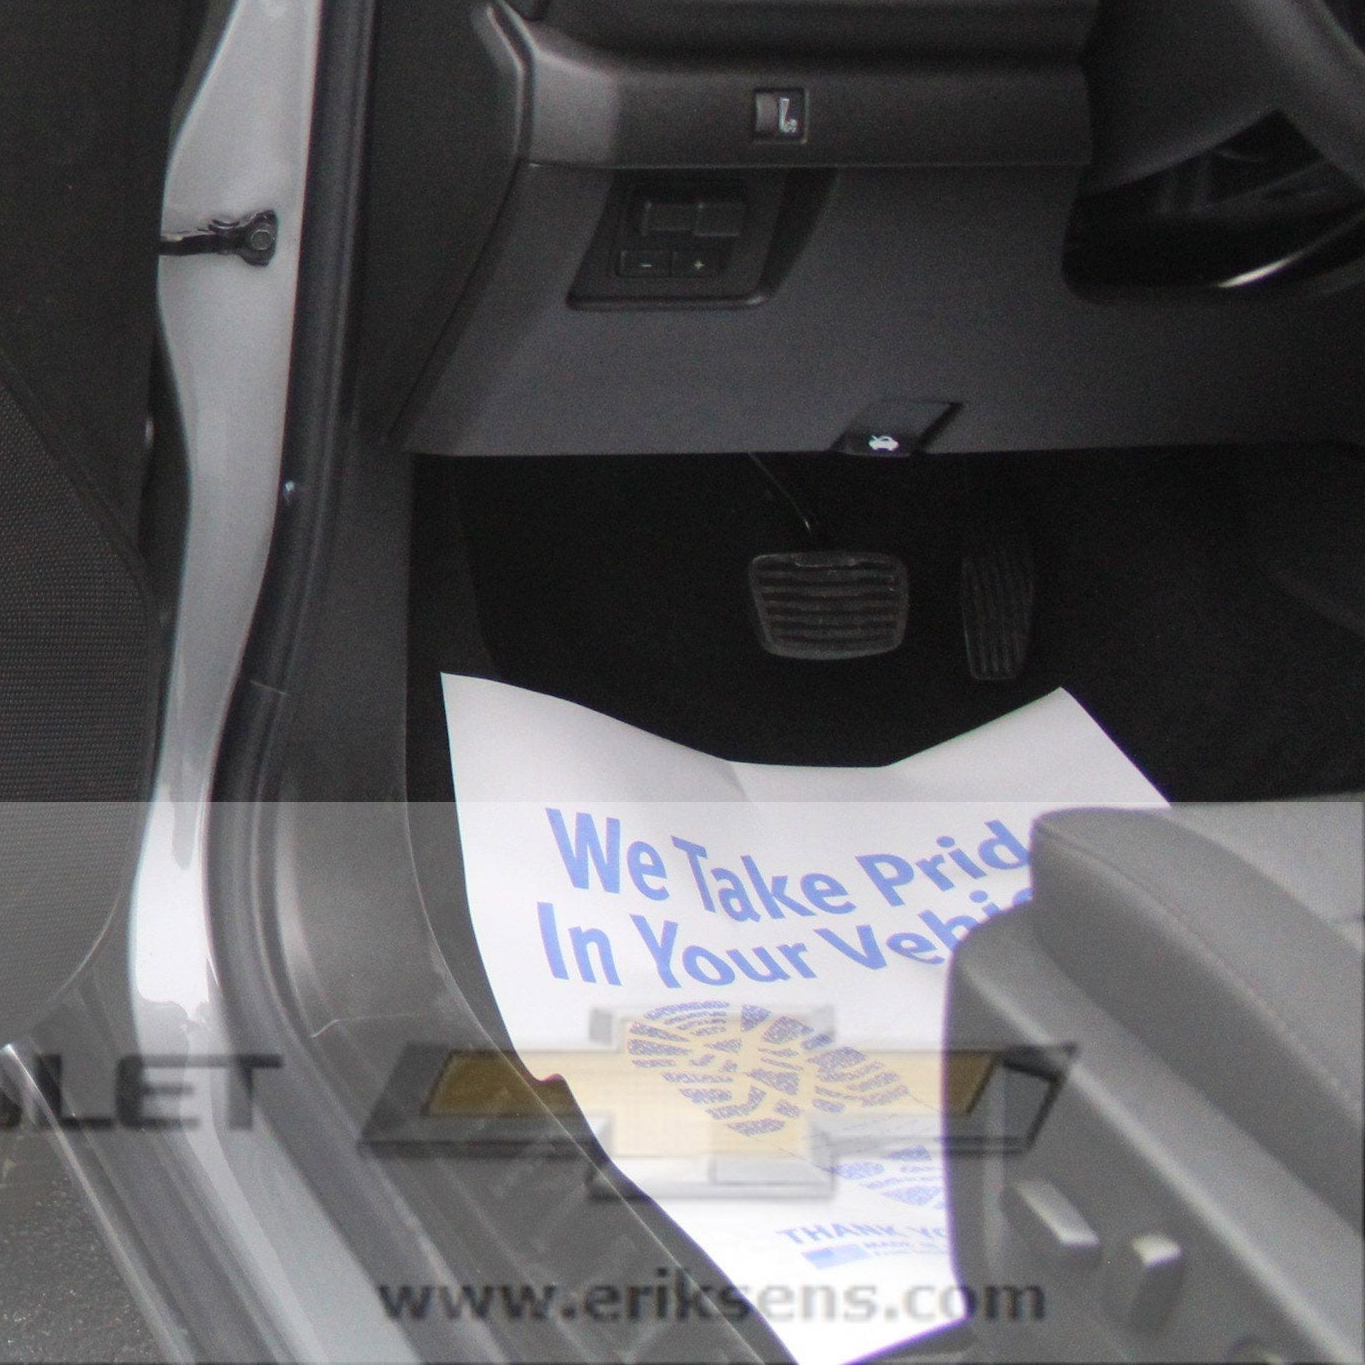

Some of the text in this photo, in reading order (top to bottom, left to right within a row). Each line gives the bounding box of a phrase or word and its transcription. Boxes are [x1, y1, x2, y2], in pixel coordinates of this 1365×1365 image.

[545, 807, 1033, 924] We Take Prid
[536, 887, 1034, 989] In Your Vehi
